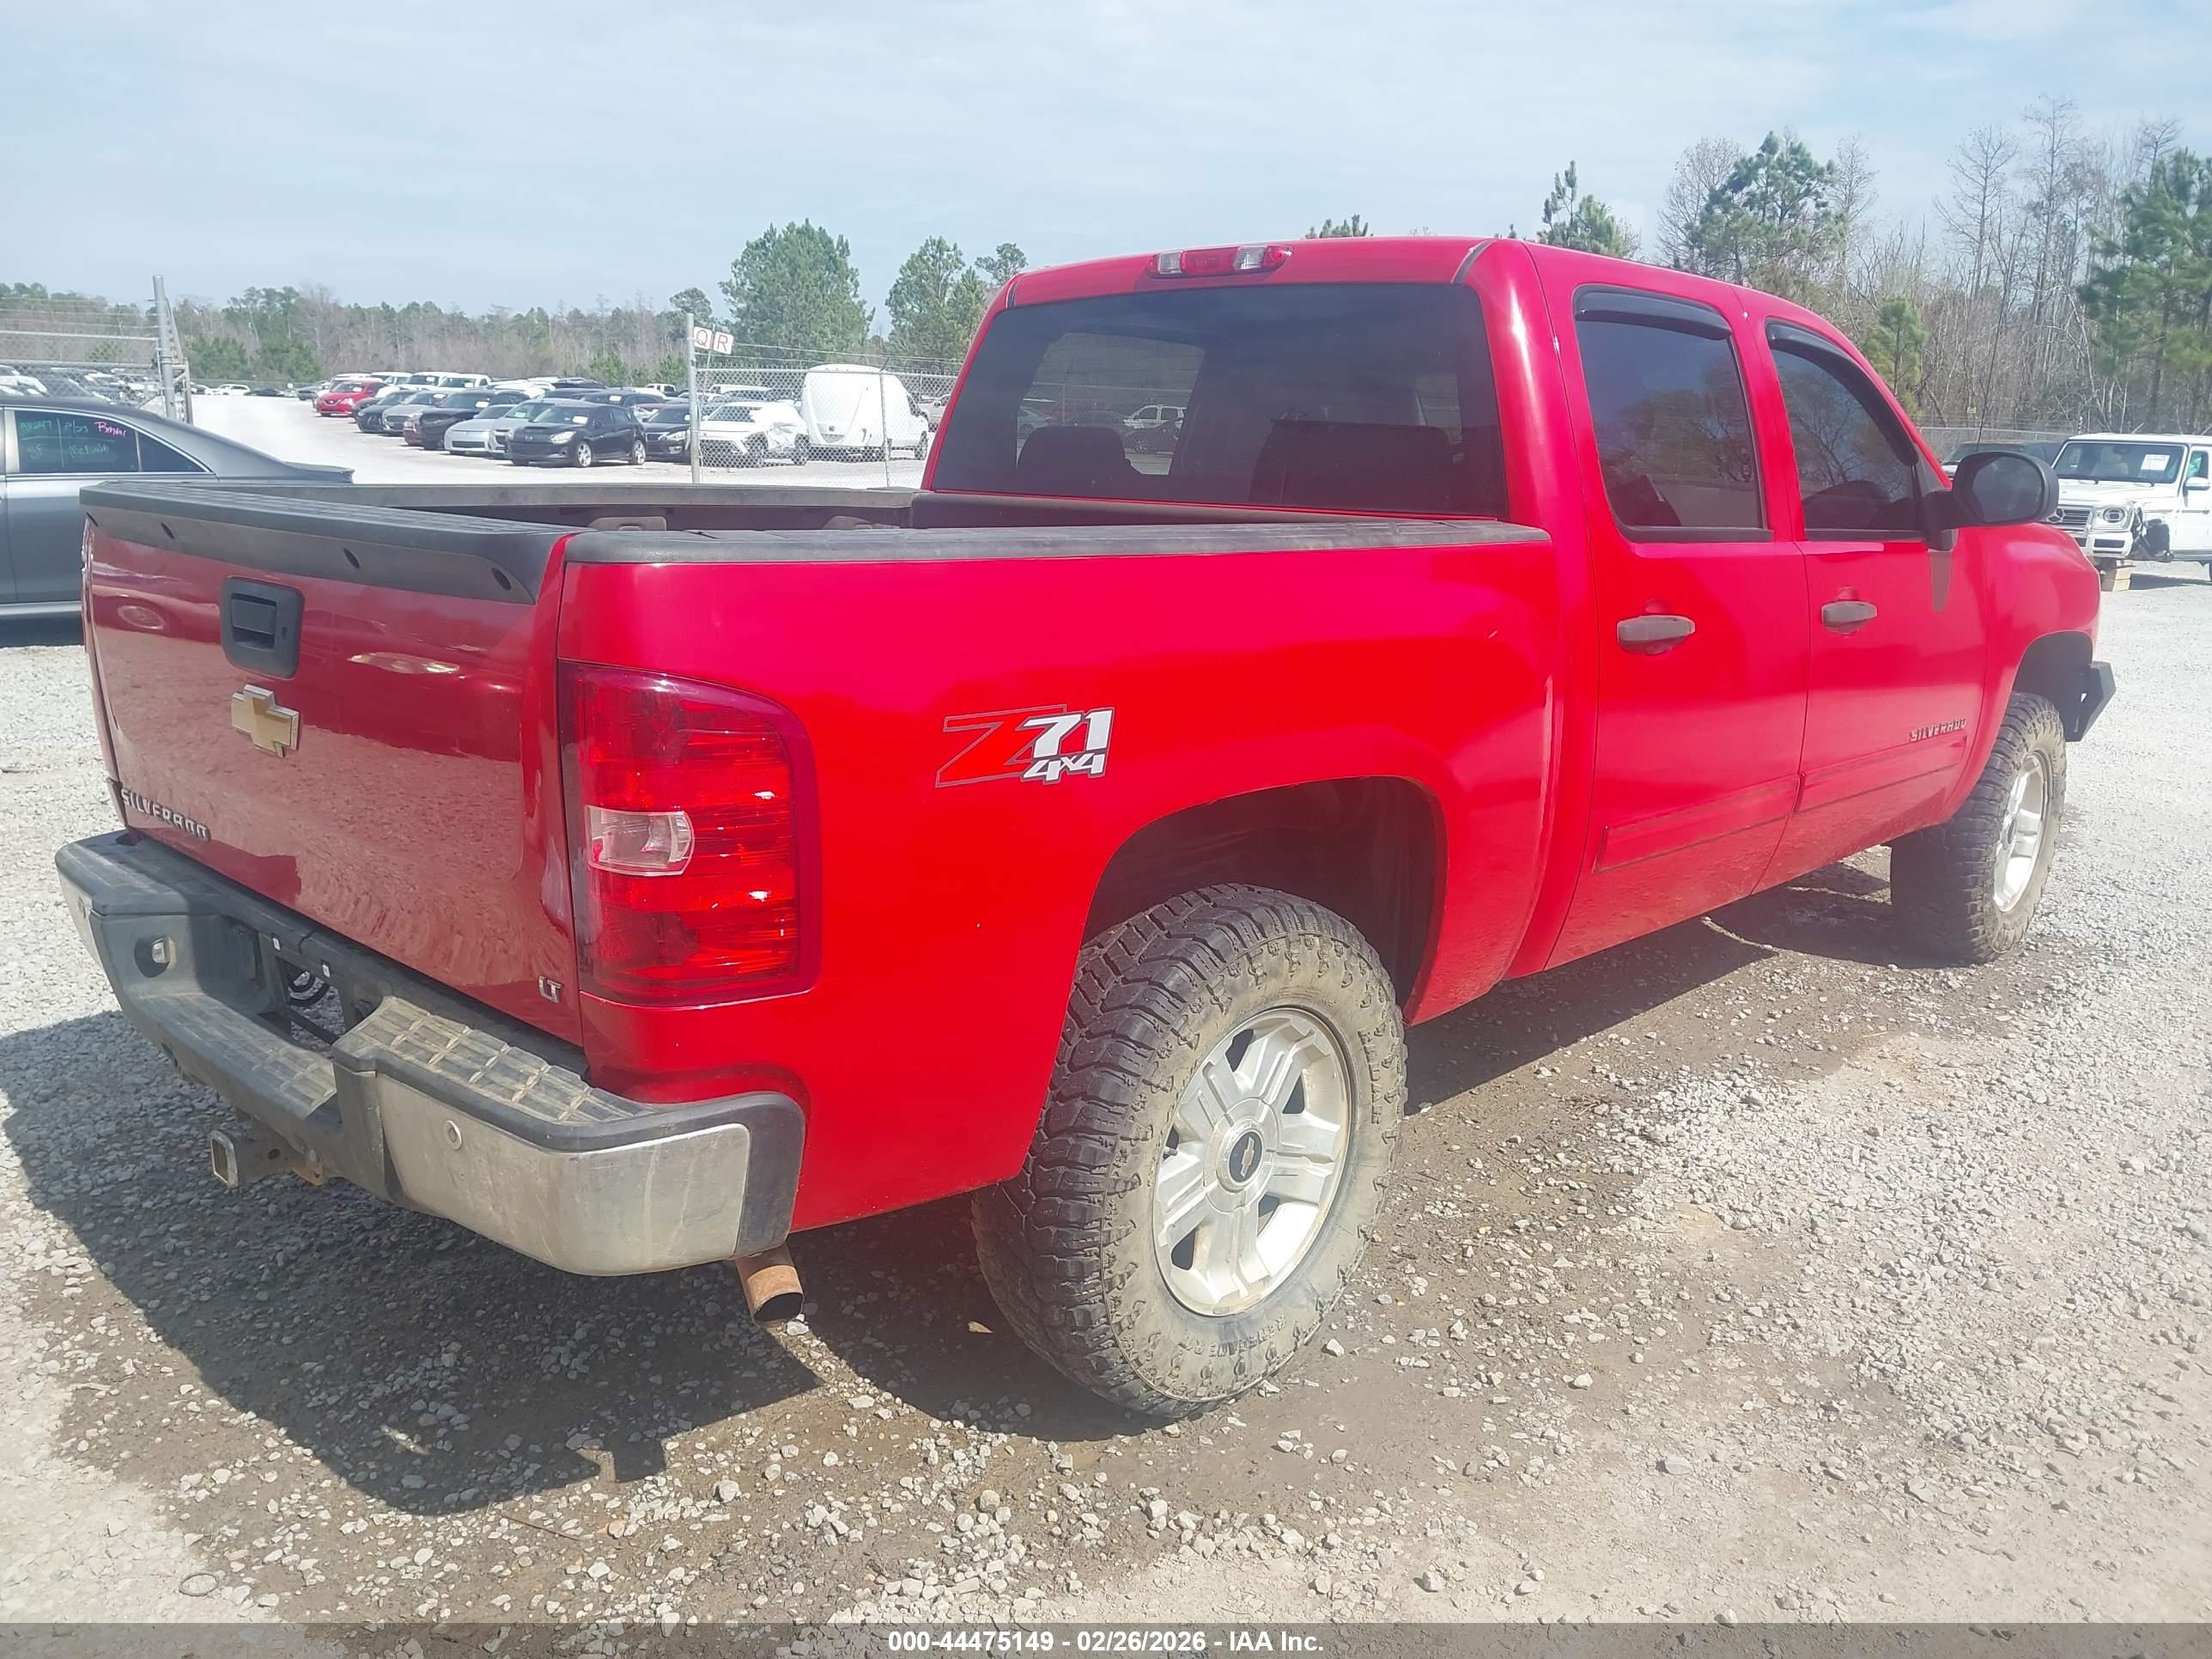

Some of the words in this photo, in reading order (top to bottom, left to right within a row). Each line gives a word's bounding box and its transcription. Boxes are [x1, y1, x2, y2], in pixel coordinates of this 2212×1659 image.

[696, 329, 708, 348] Q
[717, 334, 728, 352] R
[1910, 718, 1966, 742] SILVERADO
[120, 787, 211, 842] SILVERADO
[538, 975, 563, 1004] LT
